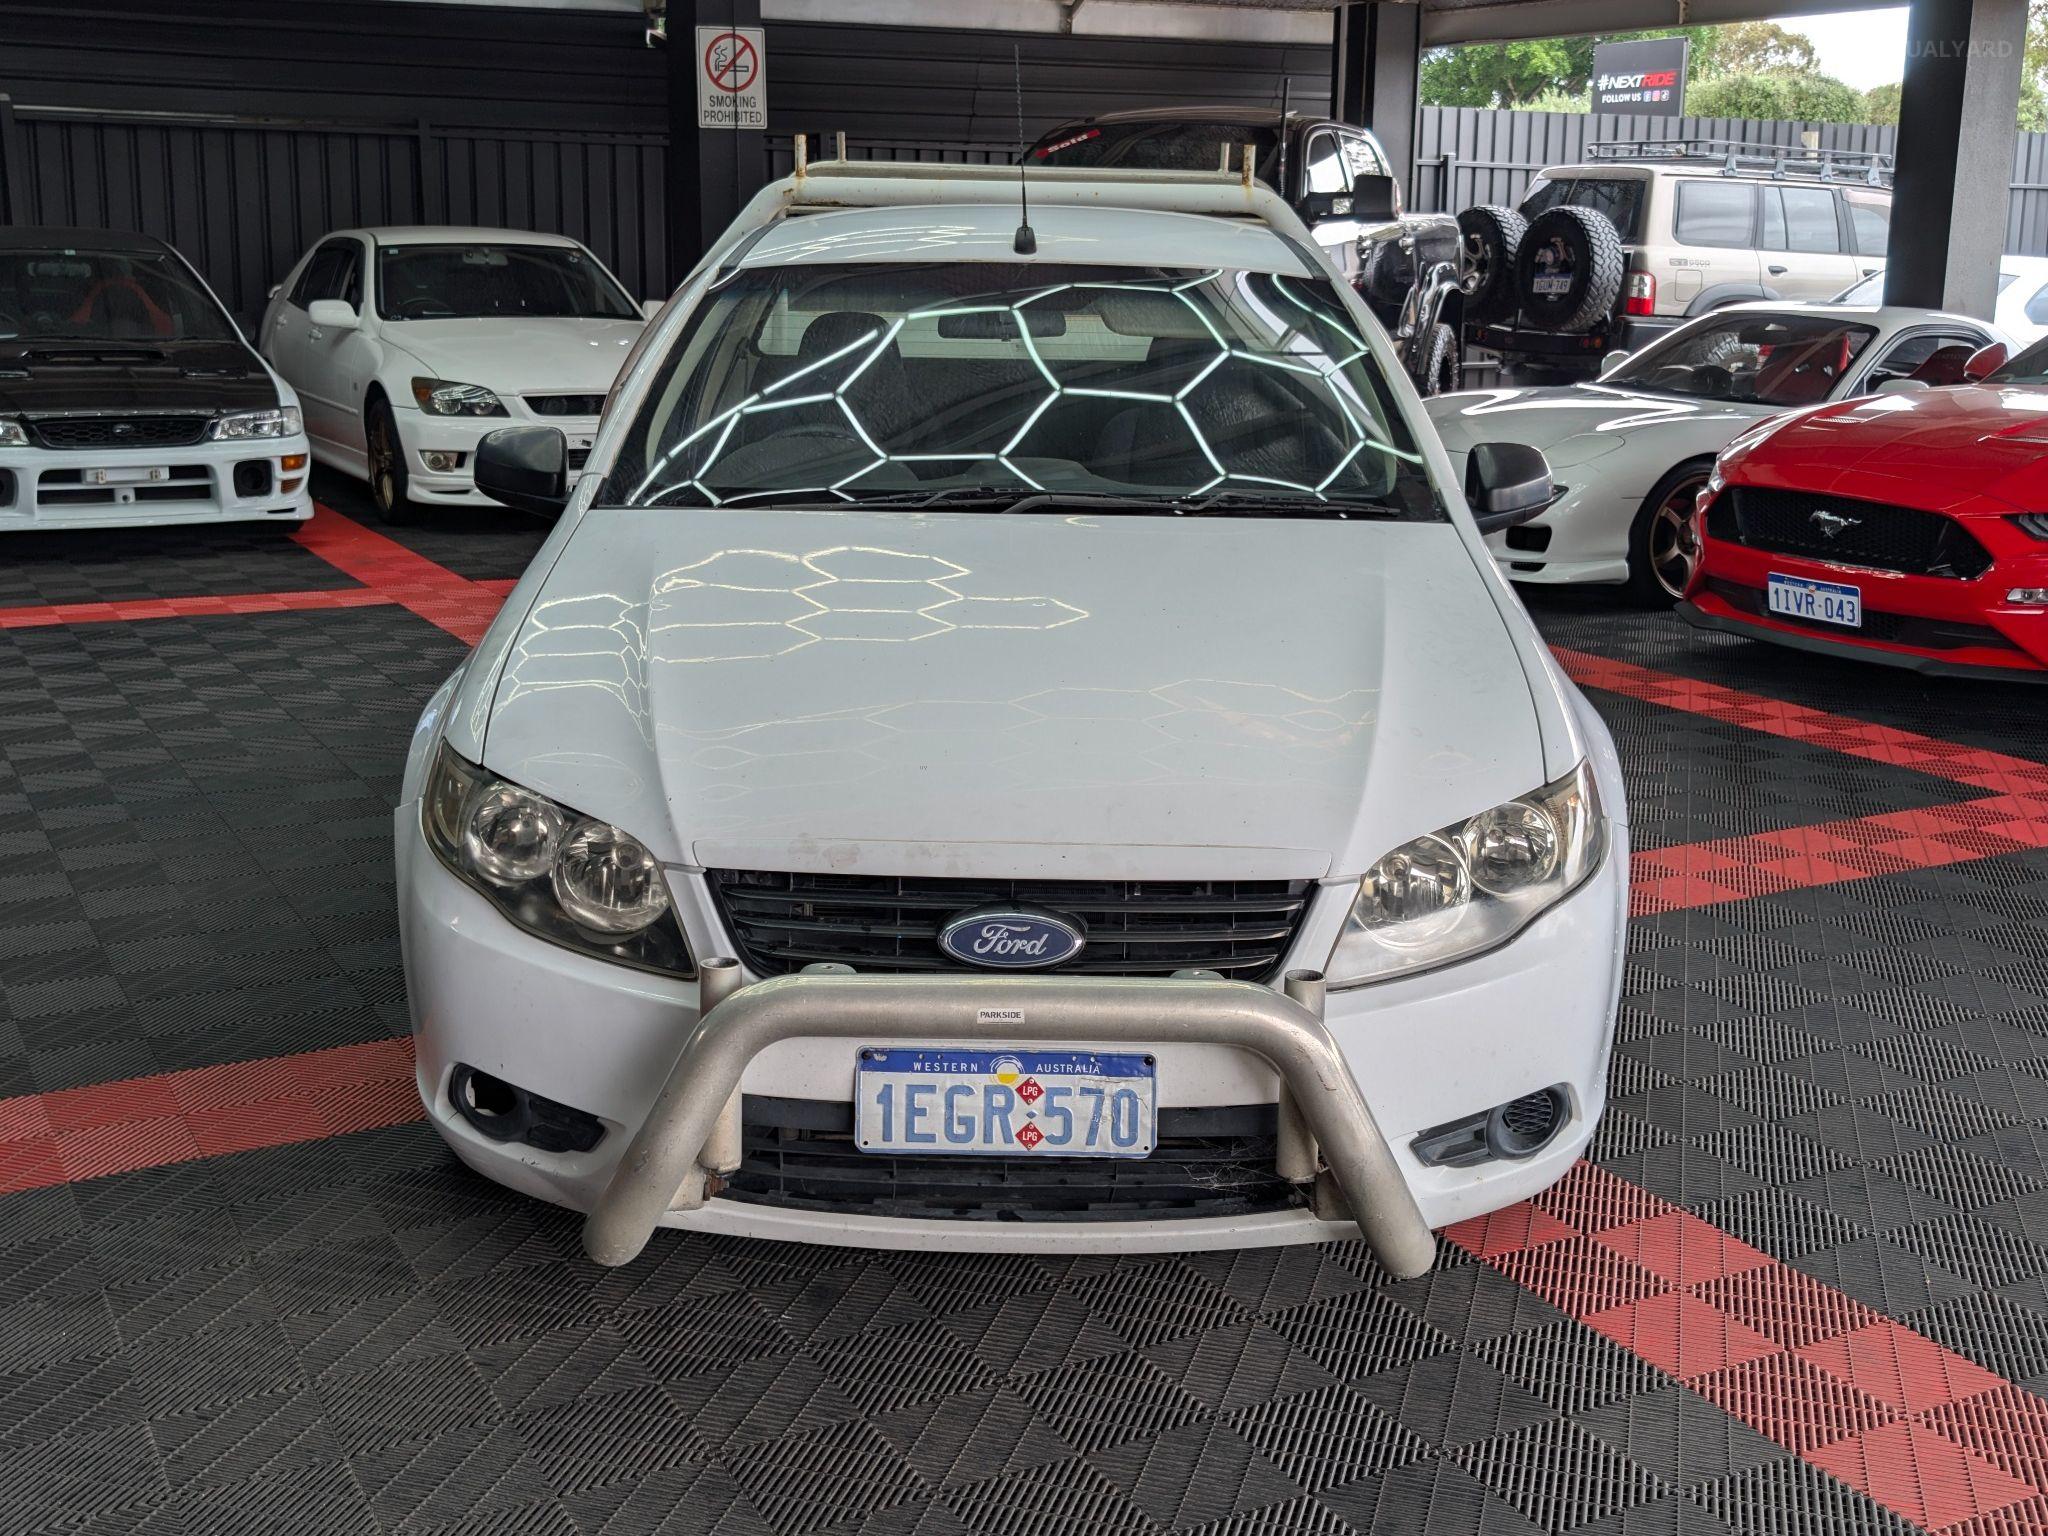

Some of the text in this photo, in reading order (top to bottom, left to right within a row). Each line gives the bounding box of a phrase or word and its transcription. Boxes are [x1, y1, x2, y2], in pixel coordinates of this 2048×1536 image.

[1597, 71, 1677, 91] #NEXTRIDE
[709, 95, 757, 108] SMOKING
[1601, 92, 1642, 104] FOLLOW US
[703, 110, 763, 123] PROHIBITED
[973, 923, 1049, 956] Ford
[979, 1010, 1022, 1019] PARKSIDE
[913, 1062, 1101, 1075] WESTERN AUSTRALIA
[1022, 1085, 1038, 1097] LPG
[1022, 1131, 1038, 1142] LPG
